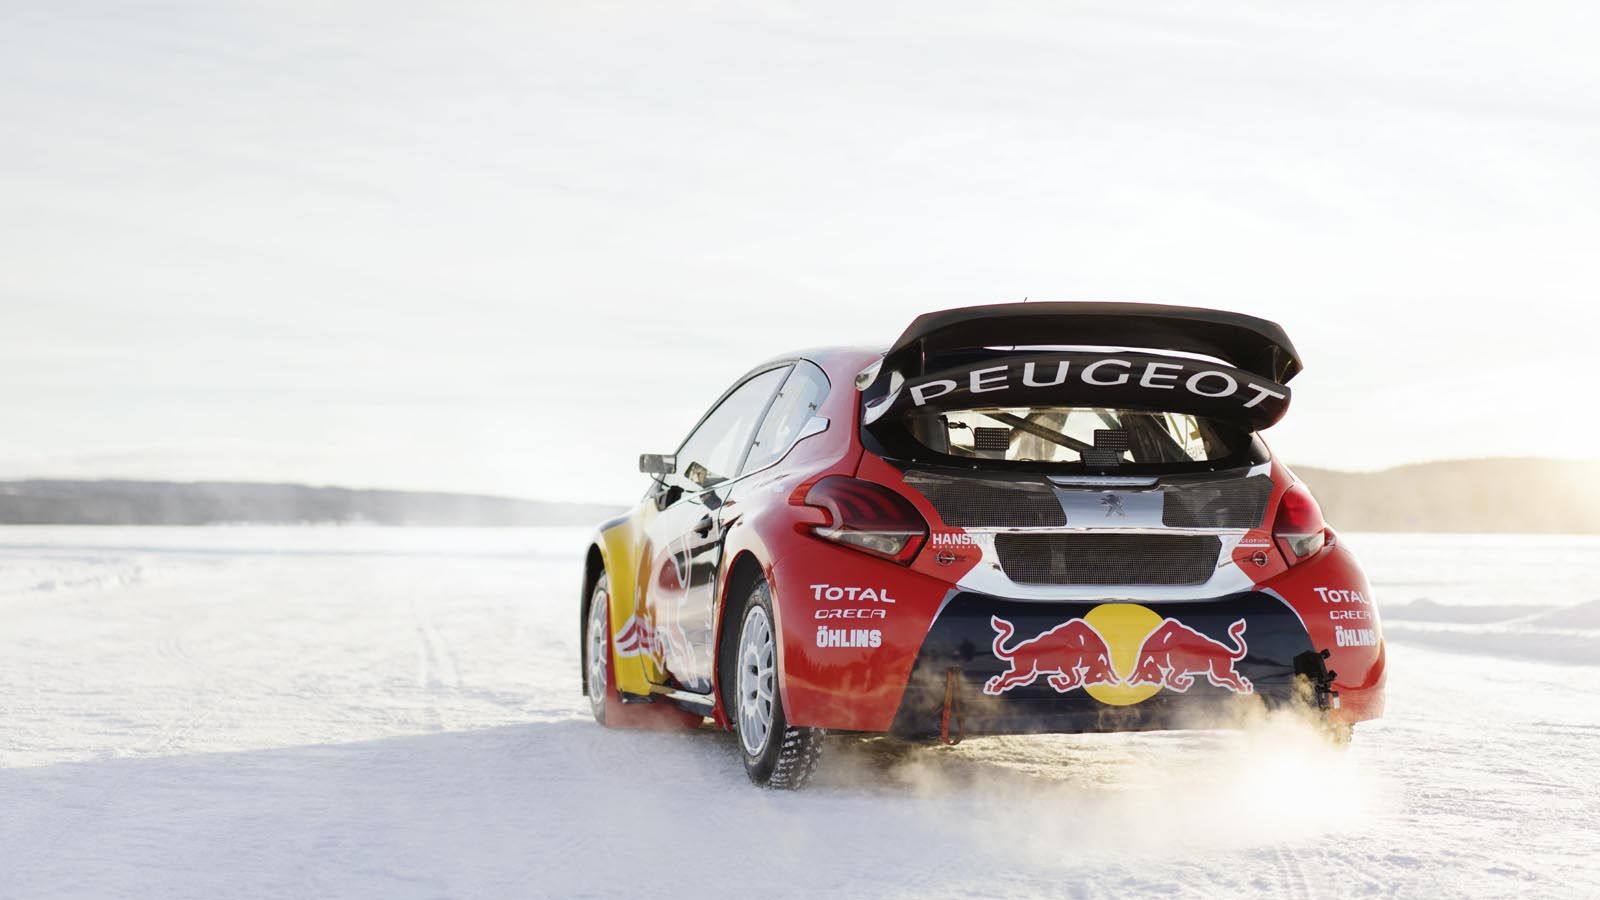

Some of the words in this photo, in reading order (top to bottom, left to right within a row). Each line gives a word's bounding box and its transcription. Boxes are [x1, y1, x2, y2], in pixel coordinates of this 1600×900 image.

[909, 359, 1286, 408] PEUGEOT
[809, 584, 896, 604] TOTAL
[1312, 587, 1370, 605] TOTAL
[814, 608, 886, 619] ORECA
[816, 625, 882, 648] ÖHLINS
[1335, 625, 1377, 648] ÖHLINS
